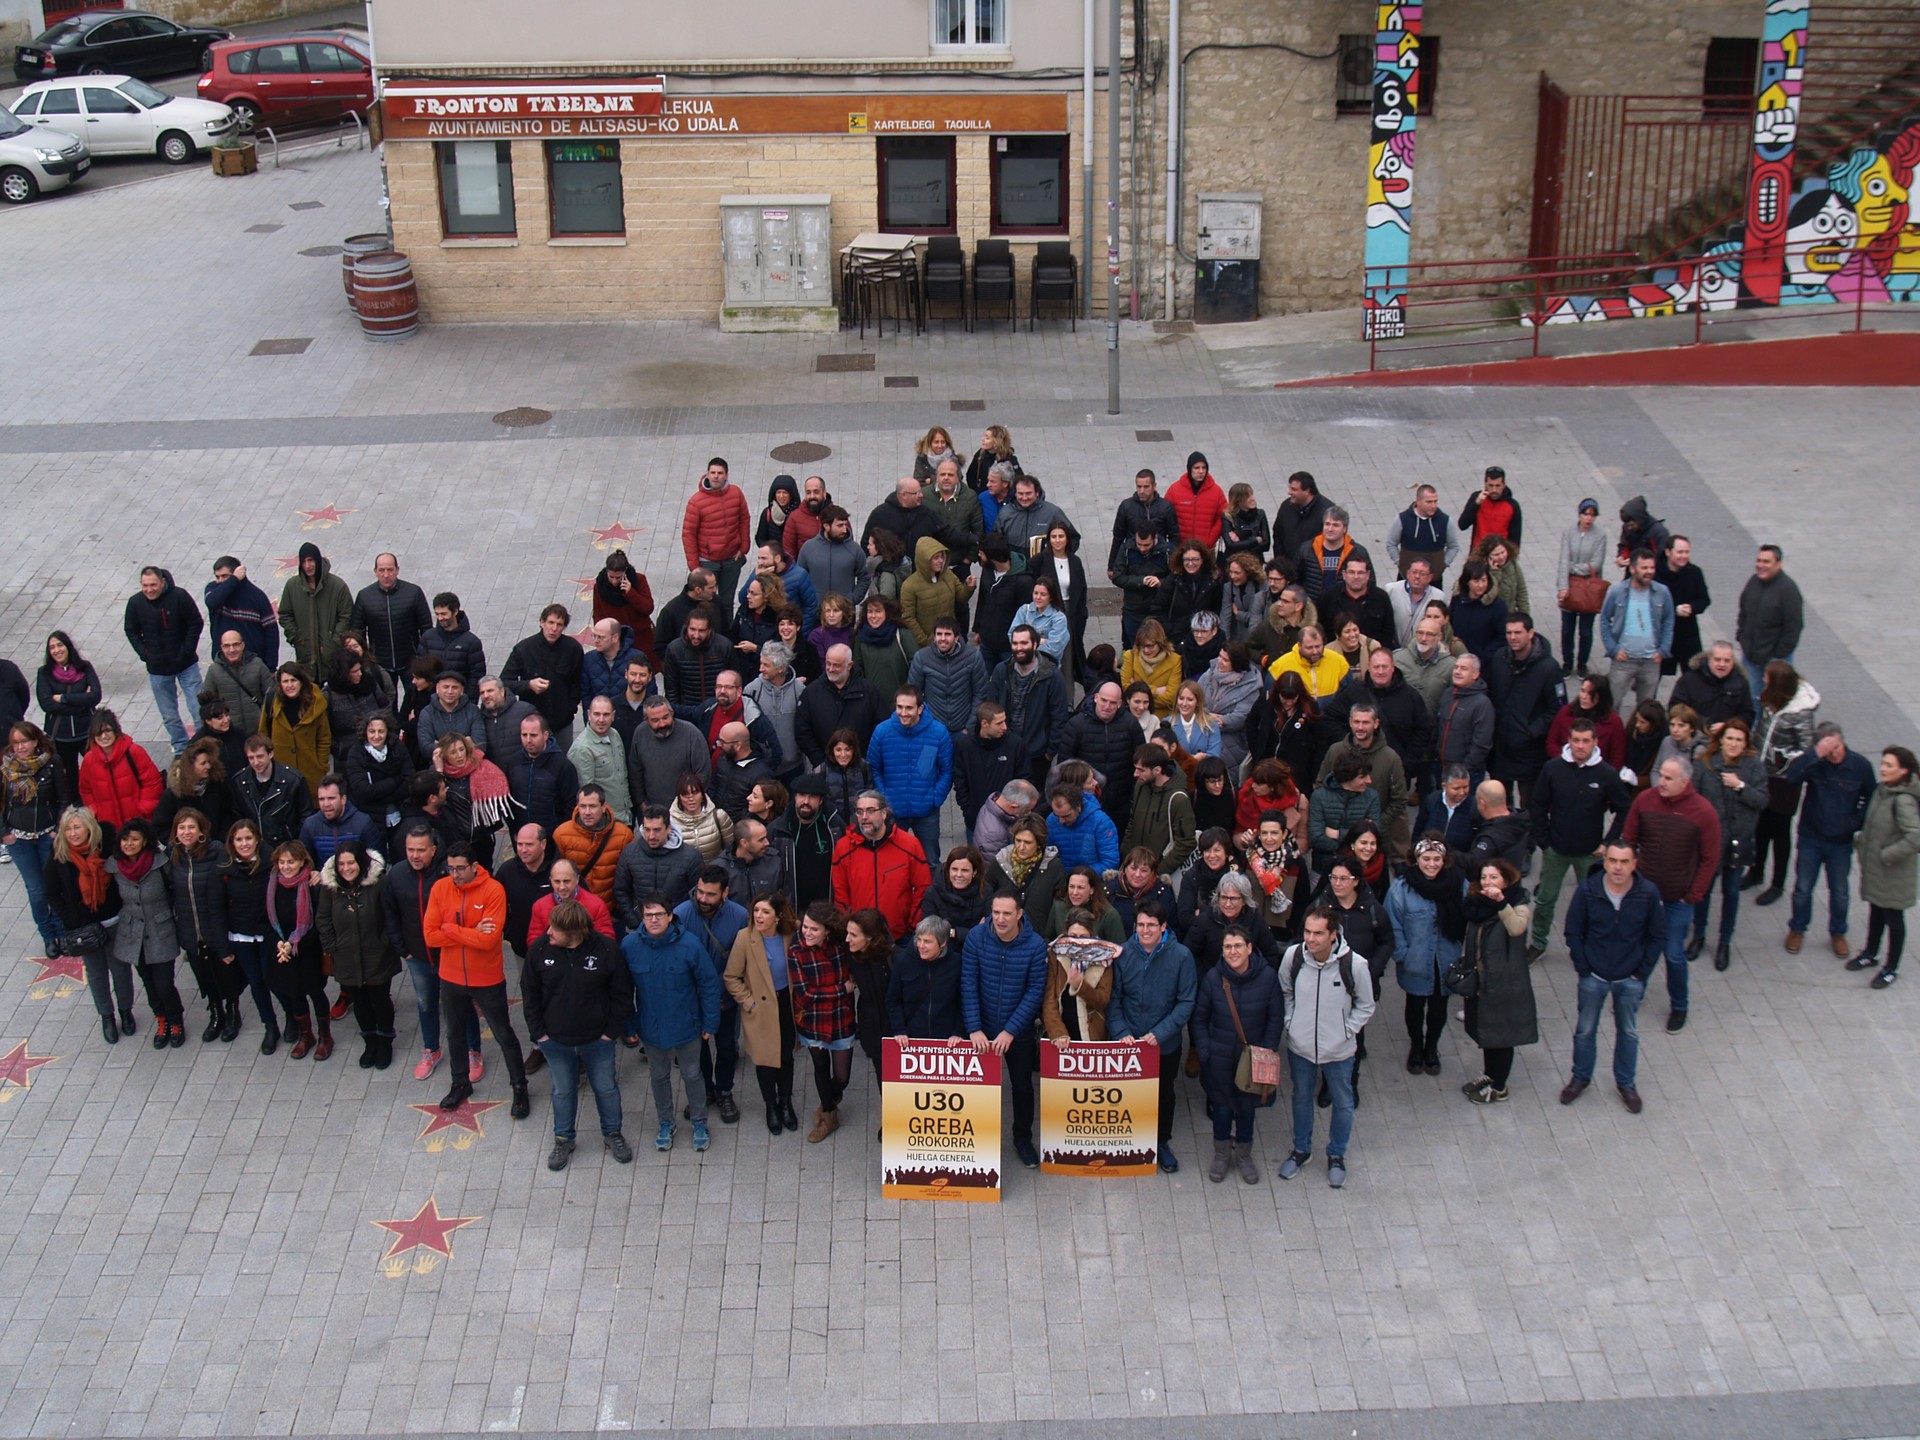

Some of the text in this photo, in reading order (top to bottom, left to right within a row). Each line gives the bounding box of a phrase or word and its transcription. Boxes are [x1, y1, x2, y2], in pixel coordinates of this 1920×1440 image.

[414, 96, 635, 115] FRONTON TABERNA
[661, 100, 714, 115] LEKUA
[428, 117, 739, 135] AYUNTAMIENTO DE ALTSASU-KO UDALA
[874, 120, 935, 130] XARTELDEGI
[944, 120, 991, 130] TAQUILLA
[900, 1046, 983, 1055] LAN-PENTSIO-BIZITZ
[900, 1053, 984, 1076] DUINA
[1059, 1054, 1142, 1073] DUINA
[914, 1091, 965, 1111] U30
[1072, 1087, 1123, 1104] U30
[1067, 1109, 1132, 1124] GREBA
[909, 1116, 975, 1136] GREBA
[1066, 1124, 1132, 1135] OROKORRA
[908, 1135, 975, 1148] OROKORRA
[1064, 1138, 1133, 1147] HUELGA GENERAL
[906, 1152, 976, 1163] HUELGA GENERAL
